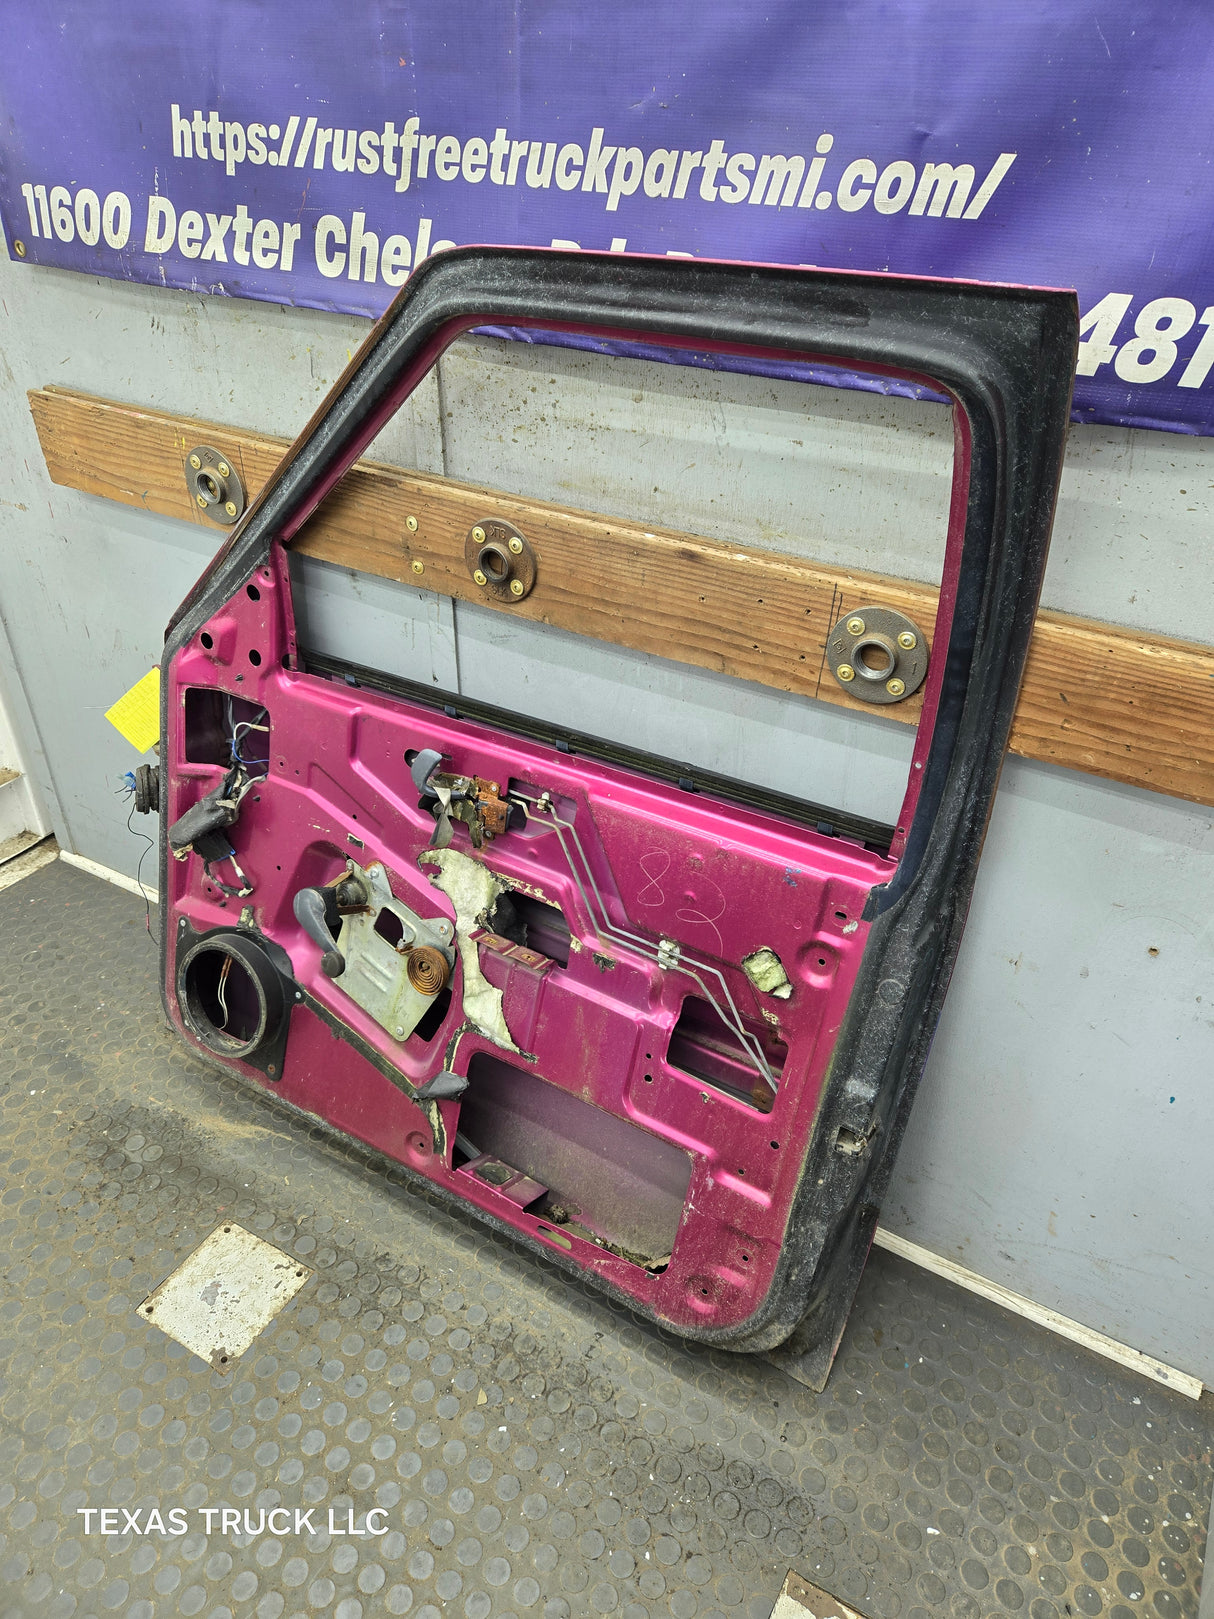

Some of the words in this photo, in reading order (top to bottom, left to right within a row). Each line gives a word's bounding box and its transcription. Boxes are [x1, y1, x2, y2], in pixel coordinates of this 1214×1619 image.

[171, 103, 1017, 220] https://rustfreetruckpartsmi.com/
[22, 182, 132, 249] 11600
[144, 195, 301, 272] Dexter
[315, 211, 457, 287] Chel
